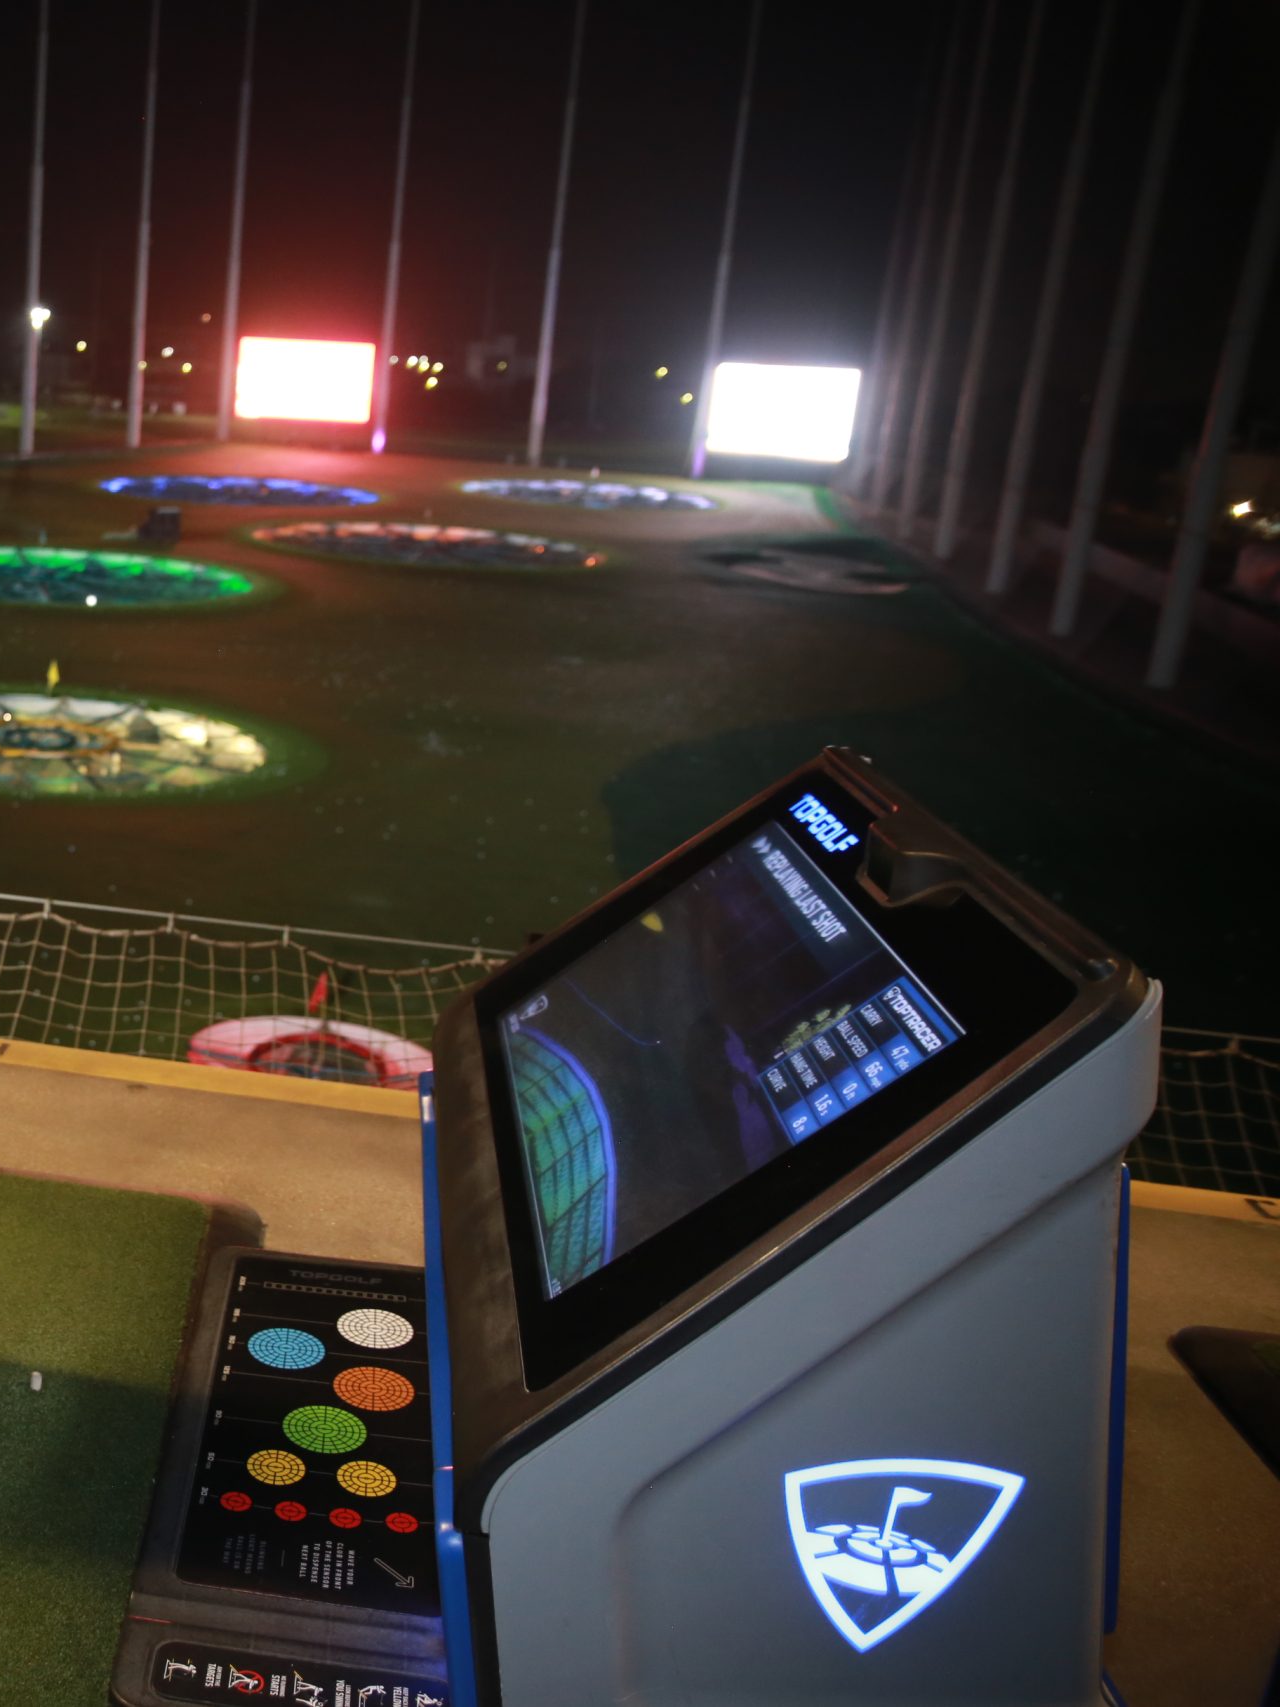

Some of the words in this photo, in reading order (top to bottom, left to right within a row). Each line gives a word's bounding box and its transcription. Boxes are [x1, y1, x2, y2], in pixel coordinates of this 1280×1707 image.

[789, 793, 860, 852] TOPGOLF
[762, 849, 810, 898] REPLAYING
[794, 889, 827, 918] LAST
[811, 910, 847, 942] SHOT
[860, 1004, 883, 1027] CARRY
[891, 1045, 910, 1060] 47
[888, 992, 942, 1052] TOPTRACER
[836, 1020, 855, 1040] BALL
[847, 1034, 868, 1058] SPEED
[864, 1061, 883, 1078] 66
[813, 1036, 836, 1061] HEIGHT
[842, 1082, 858, 1095] 0
[766, 1068, 787, 1093] CURVE
[790, 1052, 808, 1074] HANG
[800, 1068, 818, 1089] TIME
[814, 1093, 833, 1112] 1.6
[289, 1269, 383, 1285] TOPGOLF
[301, 1544, 309, 1560] NEXT
[324, 1550, 332, 1562] THE
[336, 1542, 344, 1558] CLUB
[347, 1550, 355, 1567] WAVE
[299, 1562, 307, 1577] BALL
[310, 1552, 320, 1583] DISPENSE
[322, 1563, 331, 1588] SENSOR
[334, 1569, 342, 1590] FRONT
[346, 1569, 354, 1585] YOUR
[205, 1663, 216, 1687] TARGETS
[269, 1674, 280, 1696] STARTS
[336, 1680, 345, 1692] YOU
